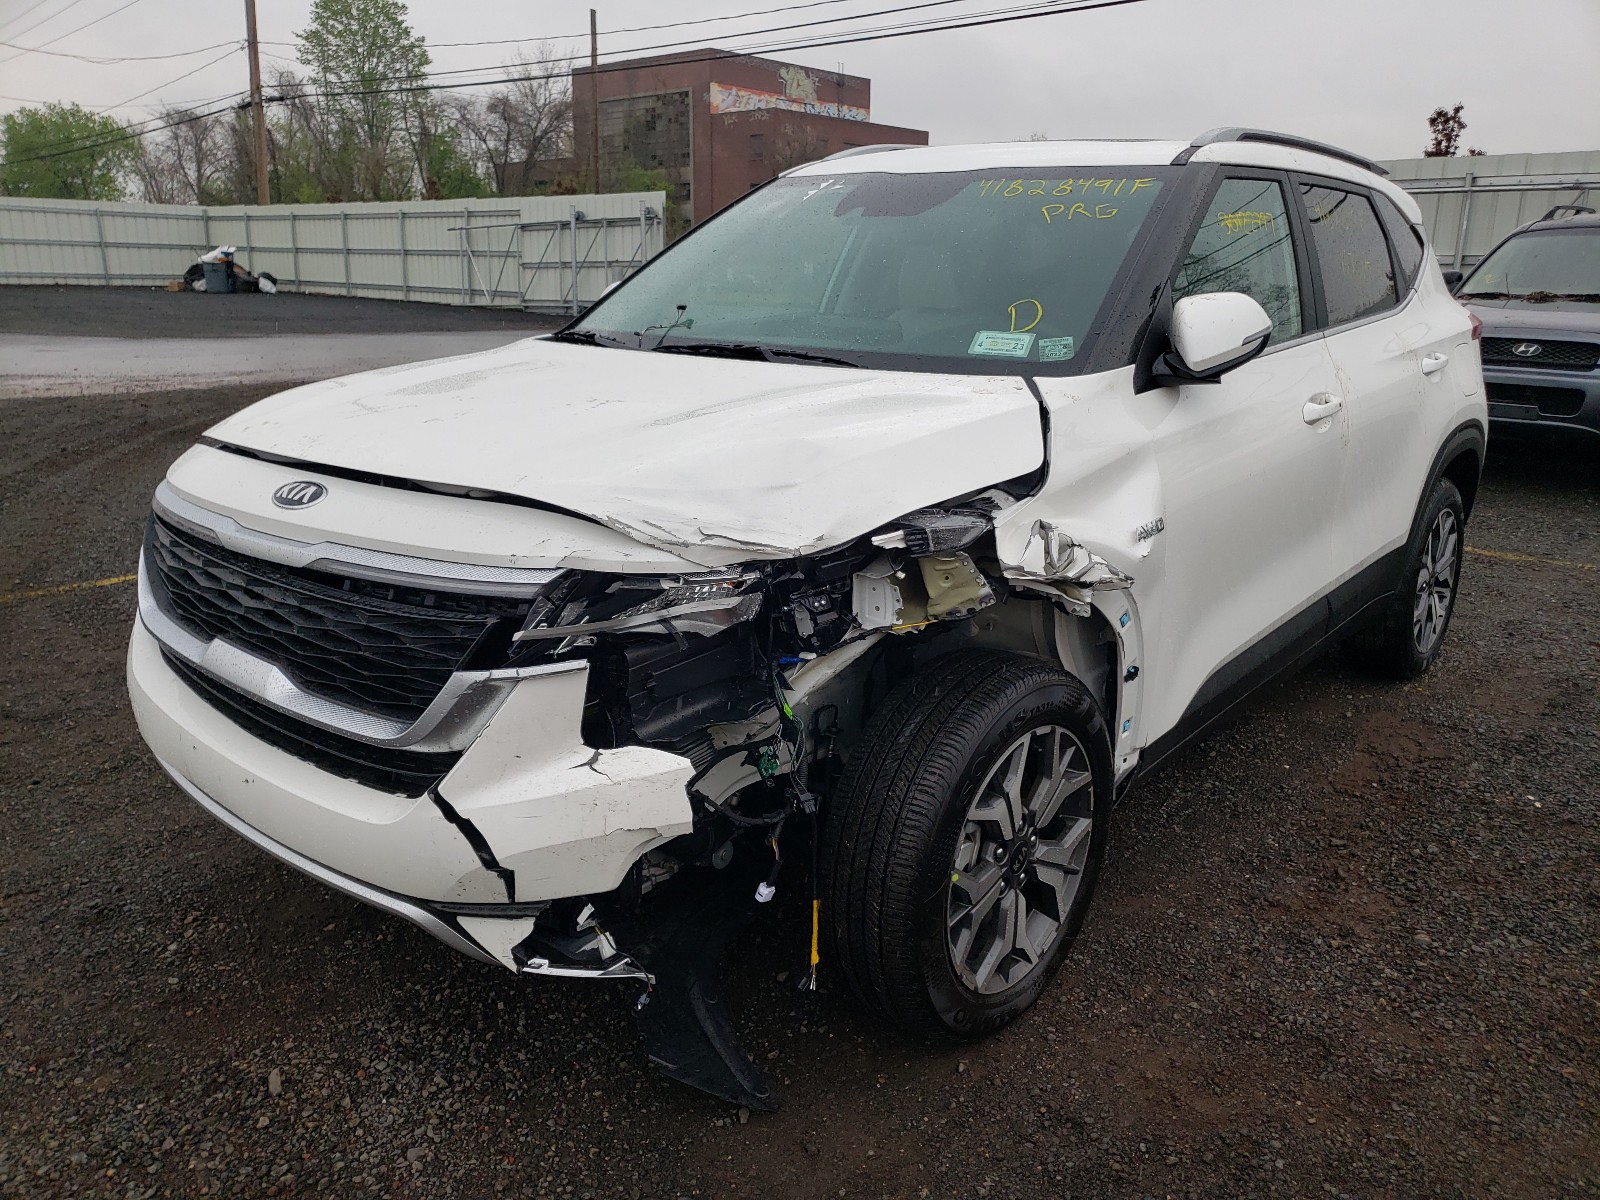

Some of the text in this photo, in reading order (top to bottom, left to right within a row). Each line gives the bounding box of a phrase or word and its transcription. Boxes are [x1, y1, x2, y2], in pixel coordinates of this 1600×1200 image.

[979, 177, 1157, 197] 41828491F
[1041, 203, 1119, 224] PRG
[1007, 298, 1043, 333] D
[1011, 342, 1025, 351] 23
[275, 482, 318, 504] KIA
